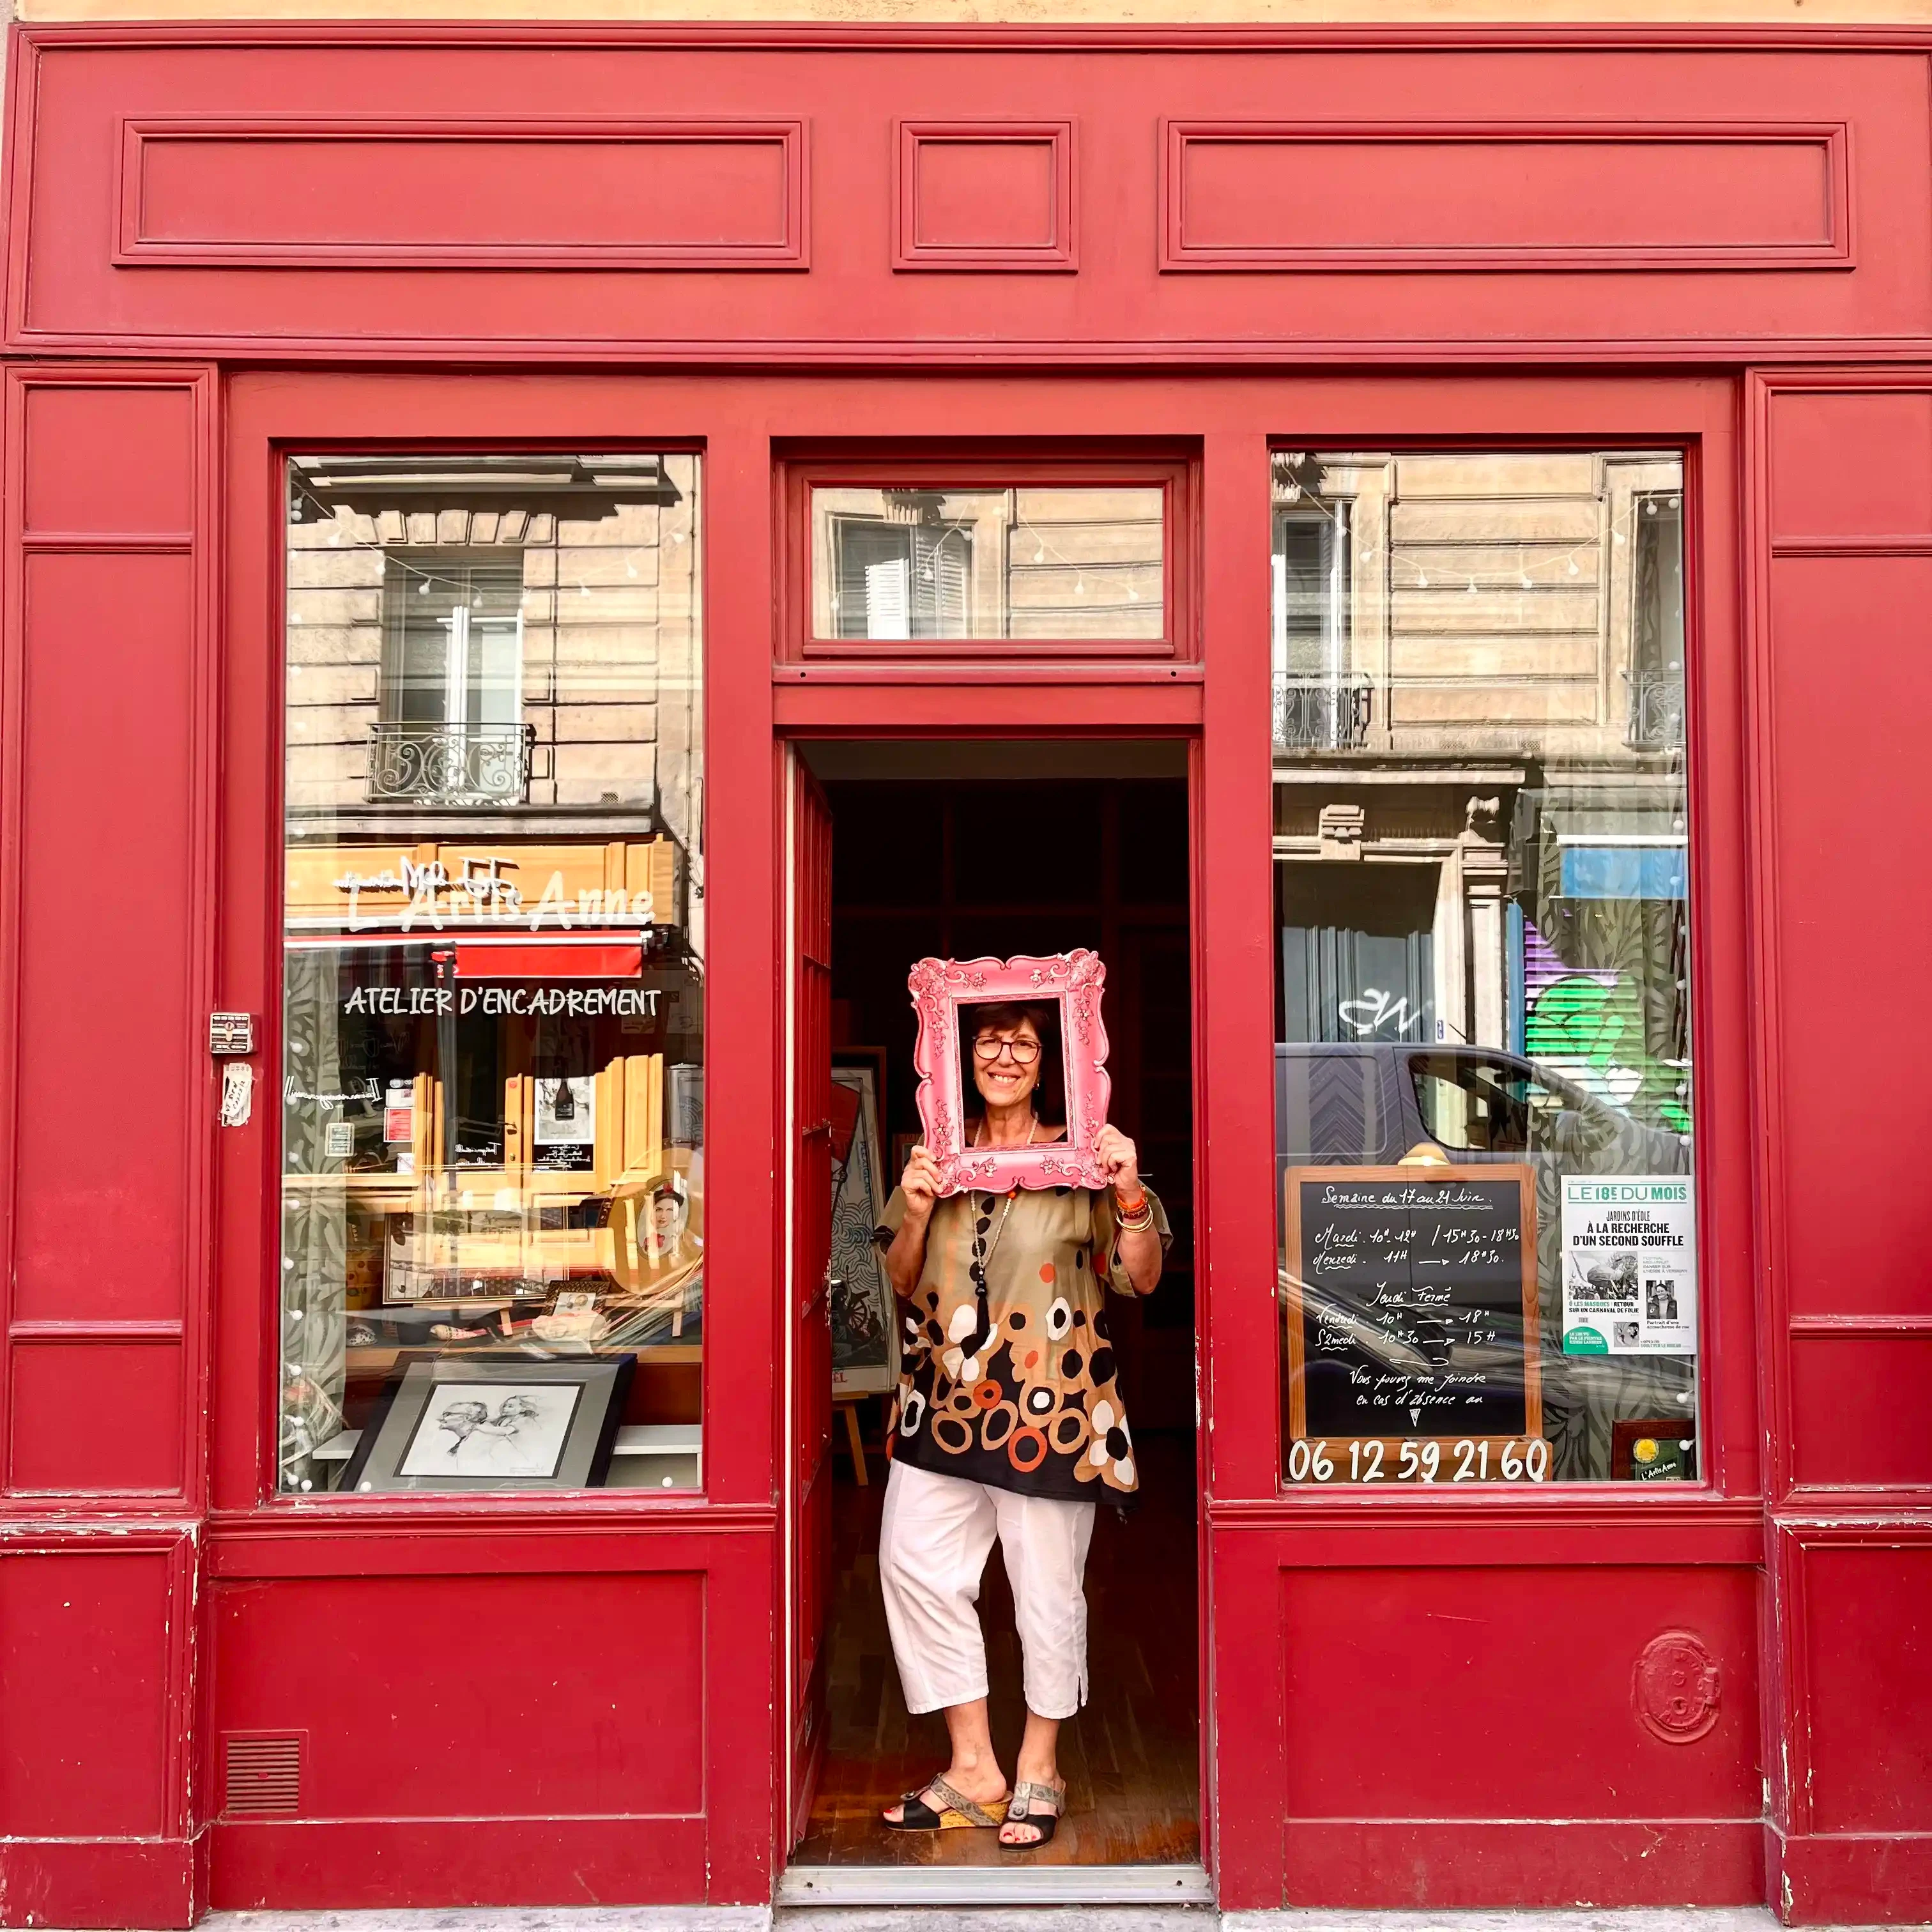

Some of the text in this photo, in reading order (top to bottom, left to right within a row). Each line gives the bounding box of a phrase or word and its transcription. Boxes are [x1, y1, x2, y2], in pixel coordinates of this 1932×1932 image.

[344, 986, 662, 1016] ATELIER D'ENCADREMENT
[1321, 1185, 1376, 1204] Semaine
[1381, 1192, 1398, 1204] du
[1399, 1188, 1416, 1204] 17
[1416, 1195, 1435, 1204] au
[1436, 1190, 1450, 1204] 21
[1568, 1186, 1592, 1200] LE
[1621, 1186, 1648, 1200] DU
[1651, 1186, 1687, 1200] MOIS
[1606, 1208, 1650, 1222] JARDINS D'ÉOLE
[1587, 1220, 1669, 1234] À LA RECHERCHE
[1573, 1236, 1684, 1246] D'UN SECOND SOUFFLE
[1366, 1282, 1407, 1307] Jeudi
[1349, 1365, 1370, 1384] Vous
[1376, 1374, 1411, 1392] pouvez
[1417, 1376, 1434, 1384] me
[1356, 1394, 1369, 1406] en
[1373, 1393, 1388, 1406] cas
[1466, 1395, 1483, 1404] au
[1289, 1439, 1334, 1482] 06
[1348, 1439, 1385, 1482] 12
[1397, 1440, 1441, 1483] 59
